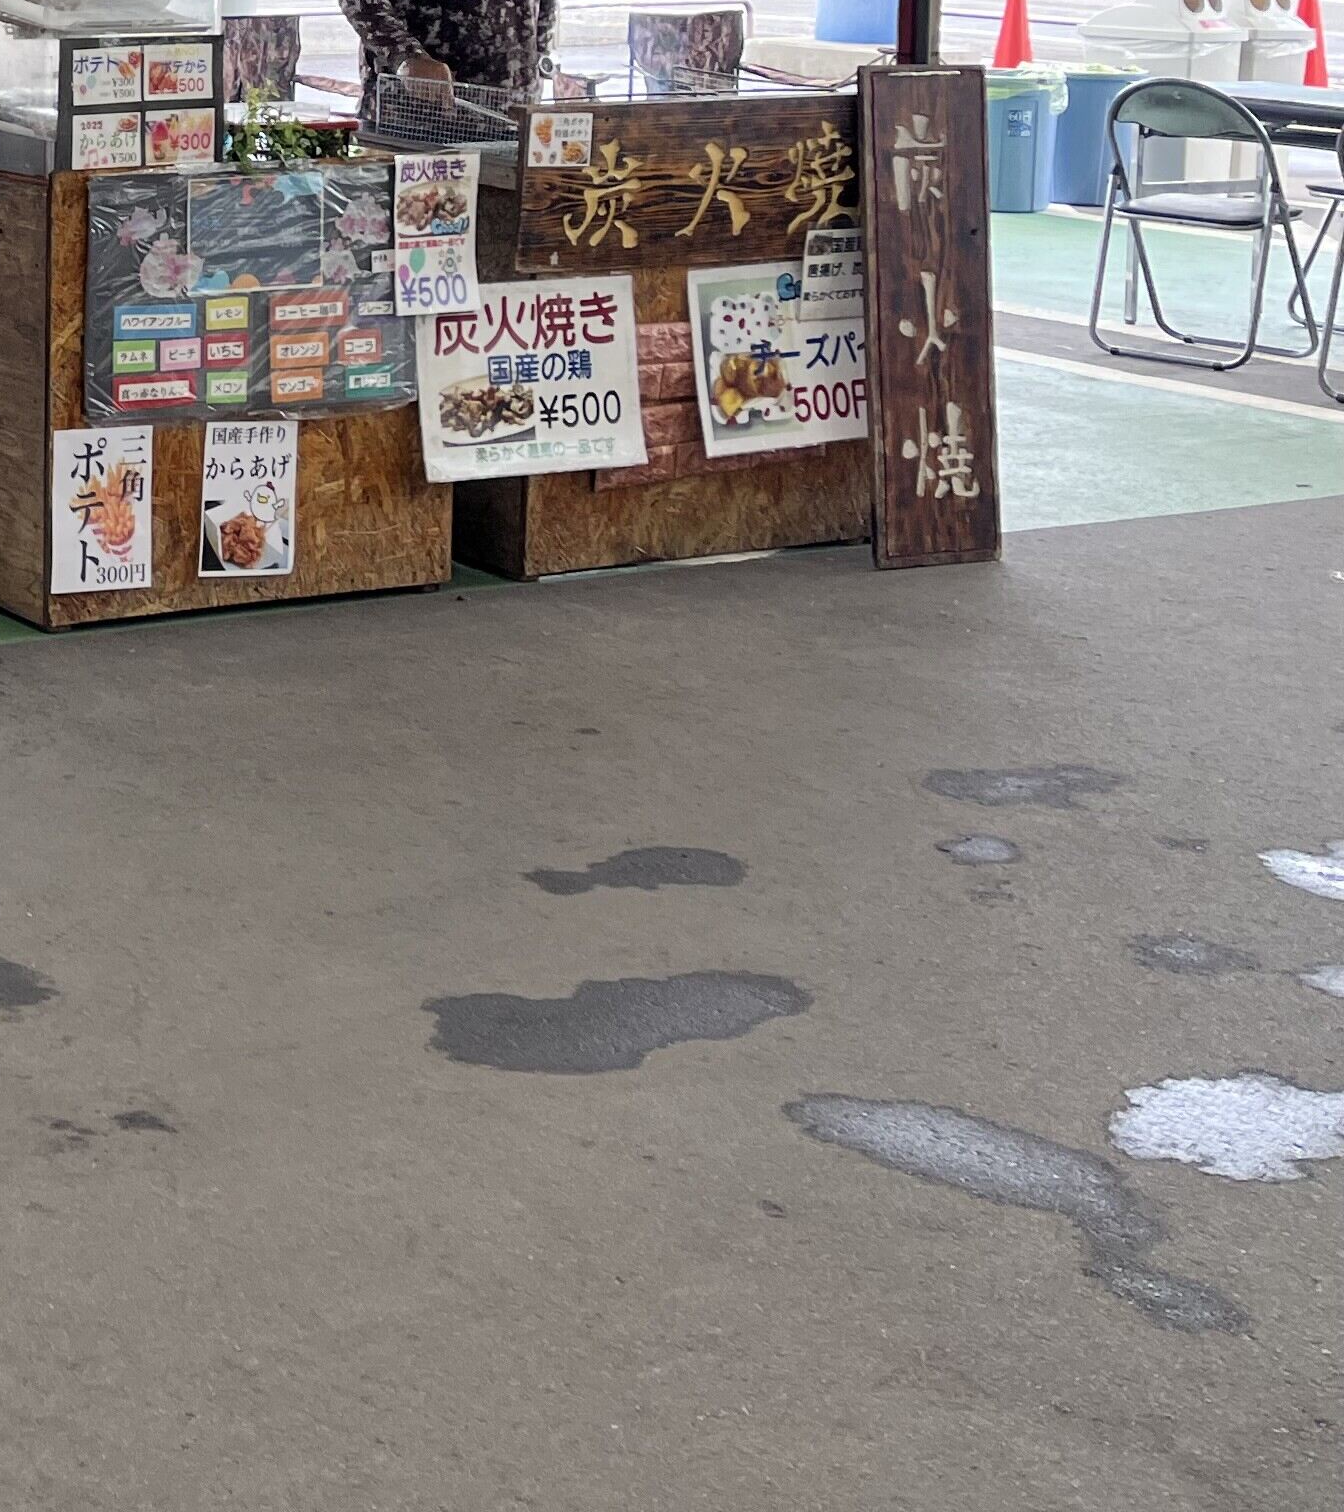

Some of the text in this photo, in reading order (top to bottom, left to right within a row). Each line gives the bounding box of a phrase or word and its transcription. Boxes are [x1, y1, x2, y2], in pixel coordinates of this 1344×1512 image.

[73, 55, 120, 74] ポテト
[400, 159, 467, 183] 炭火焼き
[563, 121, 858, 249] 炭火焼
[401, 274, 467, 308] ¥500
[215, 309, 242, 319] レモン
[892, 113, 981, 499] 炭火焼
[434, 291, 618, 356] 炭火焼き
[209, 344, 243, 357] いちご
[280, 343, 320, 357] オレンジ
[488, 349, 593, 385] 国産の鶏
[215, 382, 242, 394] メロン
[538, 390, 622, 429] ¥500
[212, 426, 286, 446] 国産手作り
[120, 435, 147, 504] 三角
[205, 453, 292, 481] からあげ
[69, 437, 107, 583] ポテト
[96, 563, 146, 585] 300円
